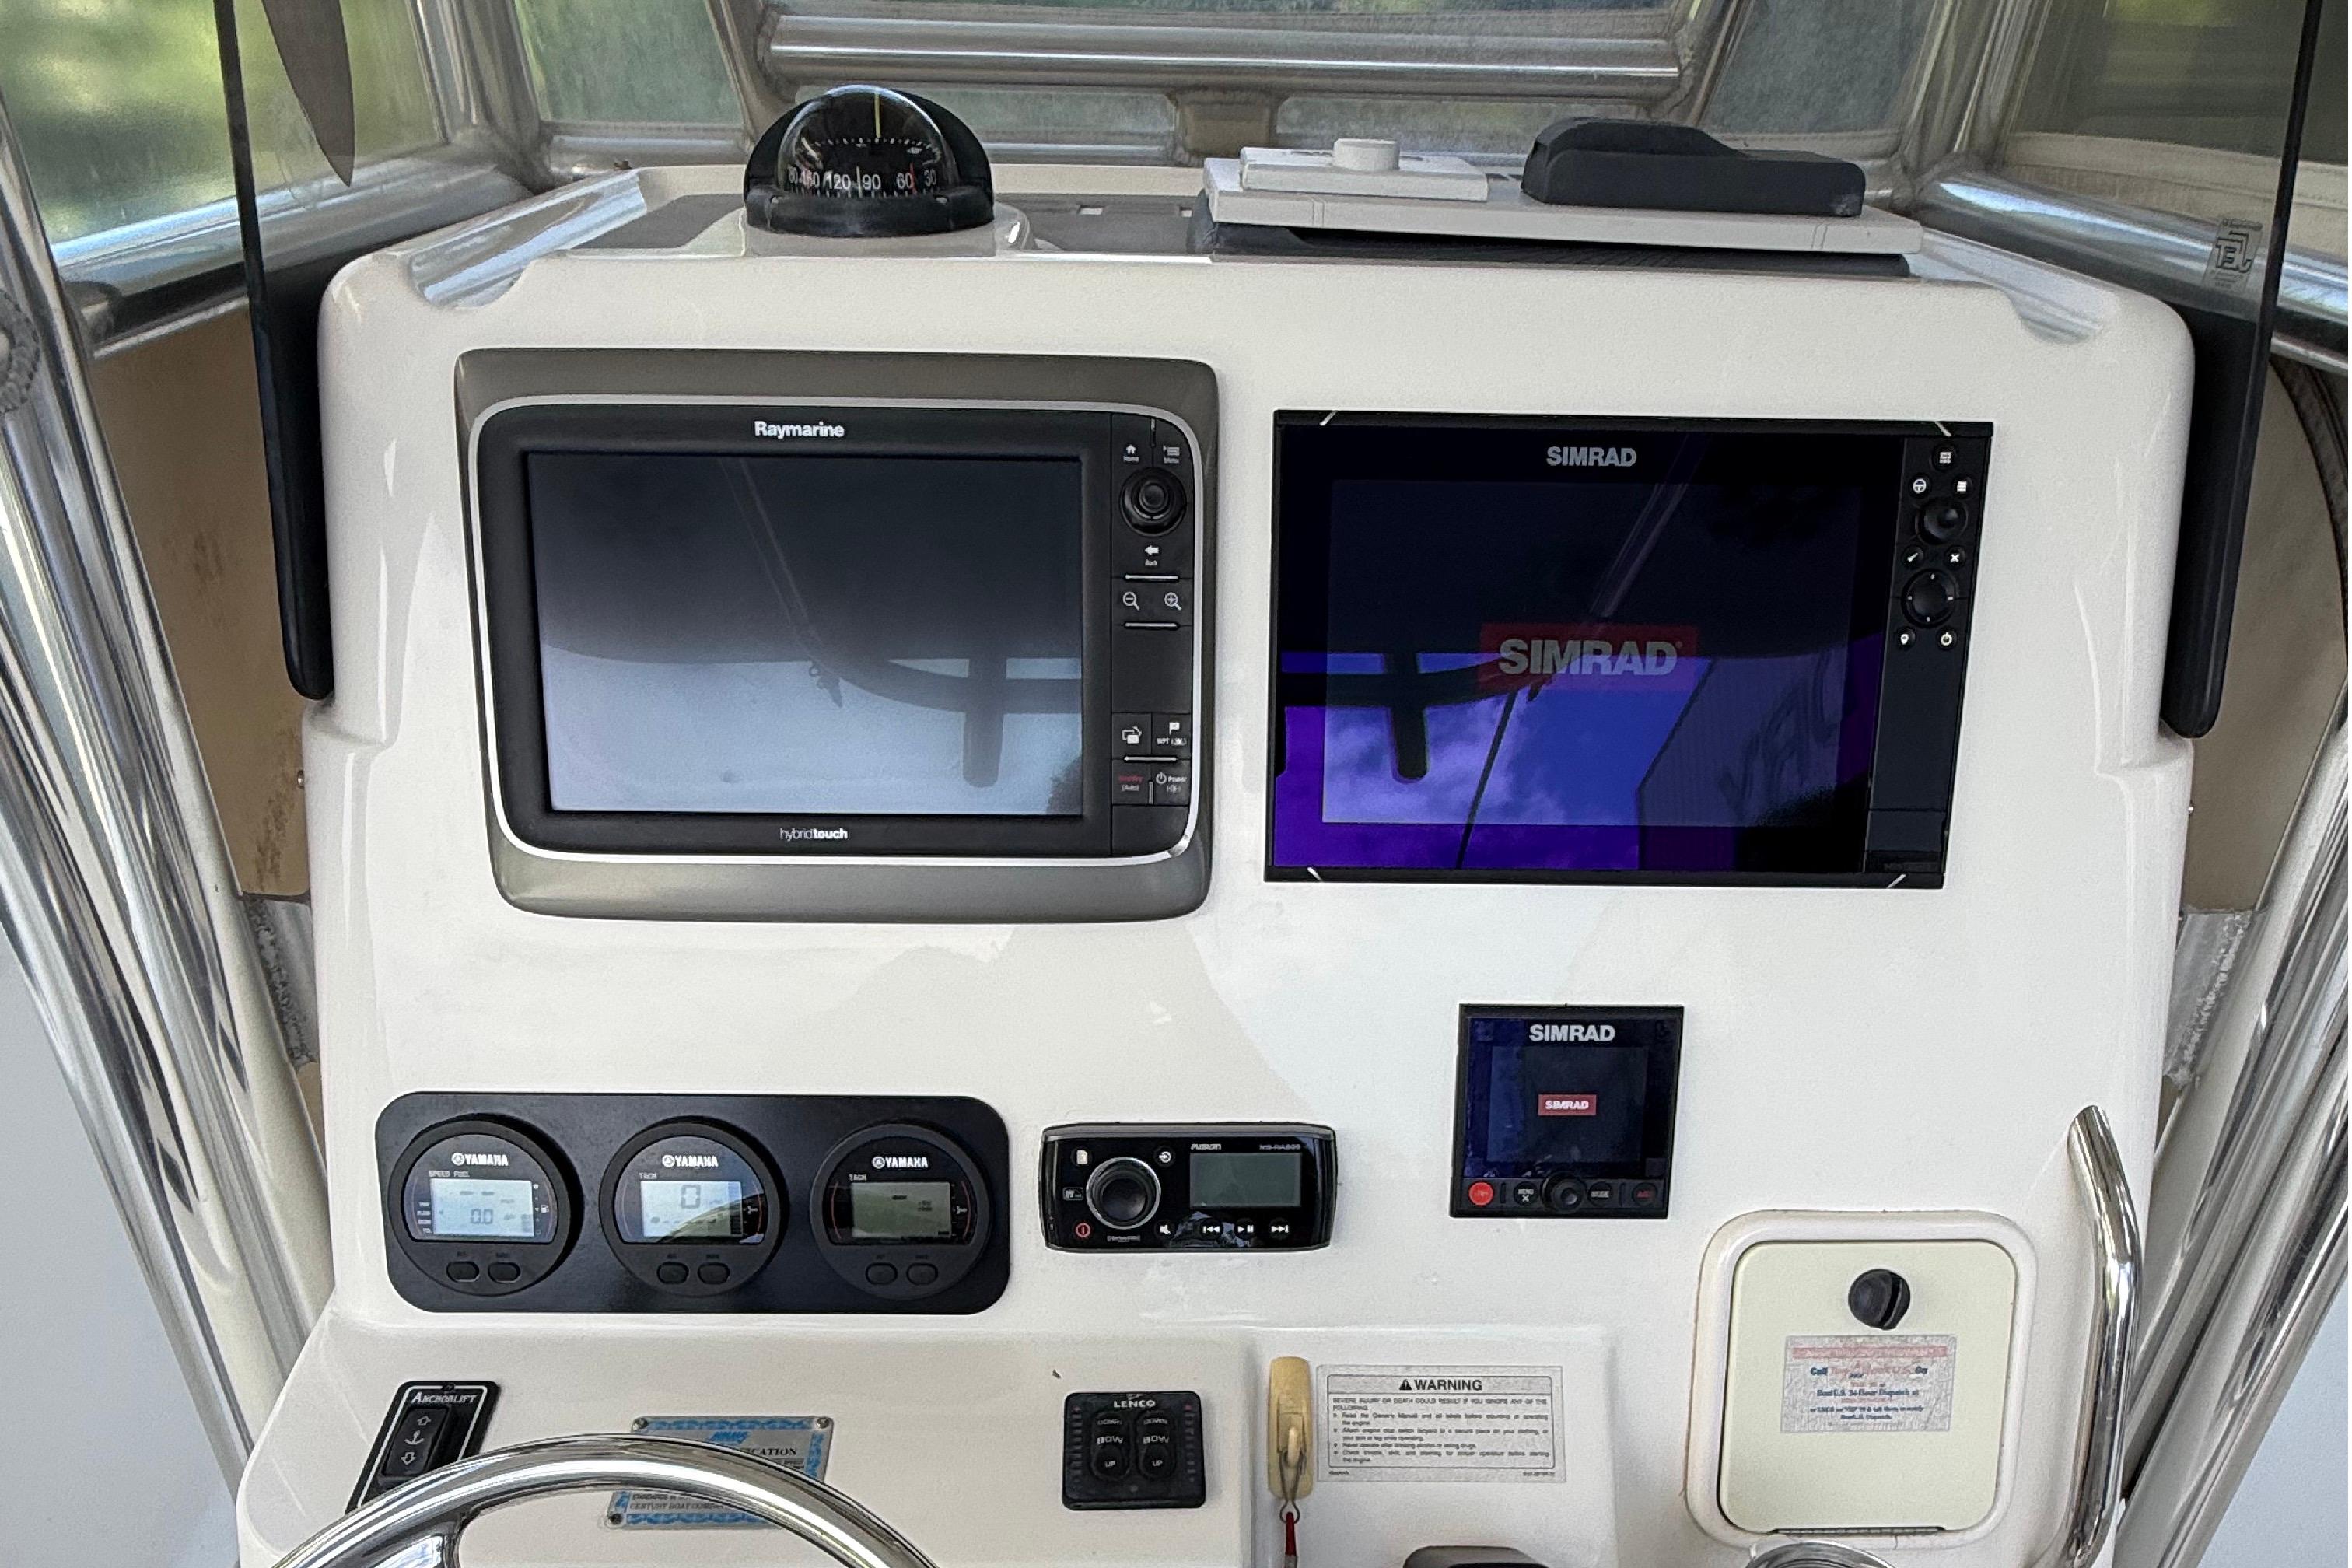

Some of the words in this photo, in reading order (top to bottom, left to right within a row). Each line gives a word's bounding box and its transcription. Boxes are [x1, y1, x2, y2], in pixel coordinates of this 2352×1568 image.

[863, 174, 881, 191] 90
[754, 421, 845, 439] Raymarine
[1546, 446, 1637, 467] SIMRAD
[1499, 639, 1678, 676] SIMRAD
[780, 828, 848, 842] hybridtouch
[1529, 1024, 1615, 1042] SIMRAD
[1545, 1101, 1590, 1110] SIMRAD
[464, 1154, 509, 1166] YAMAHA
[675, 1156, 719, 1167] YAMAHA
[885, 1157, 929, 1168] YAMAHA
[1413, 1379, 1482, 1391] WARNING
